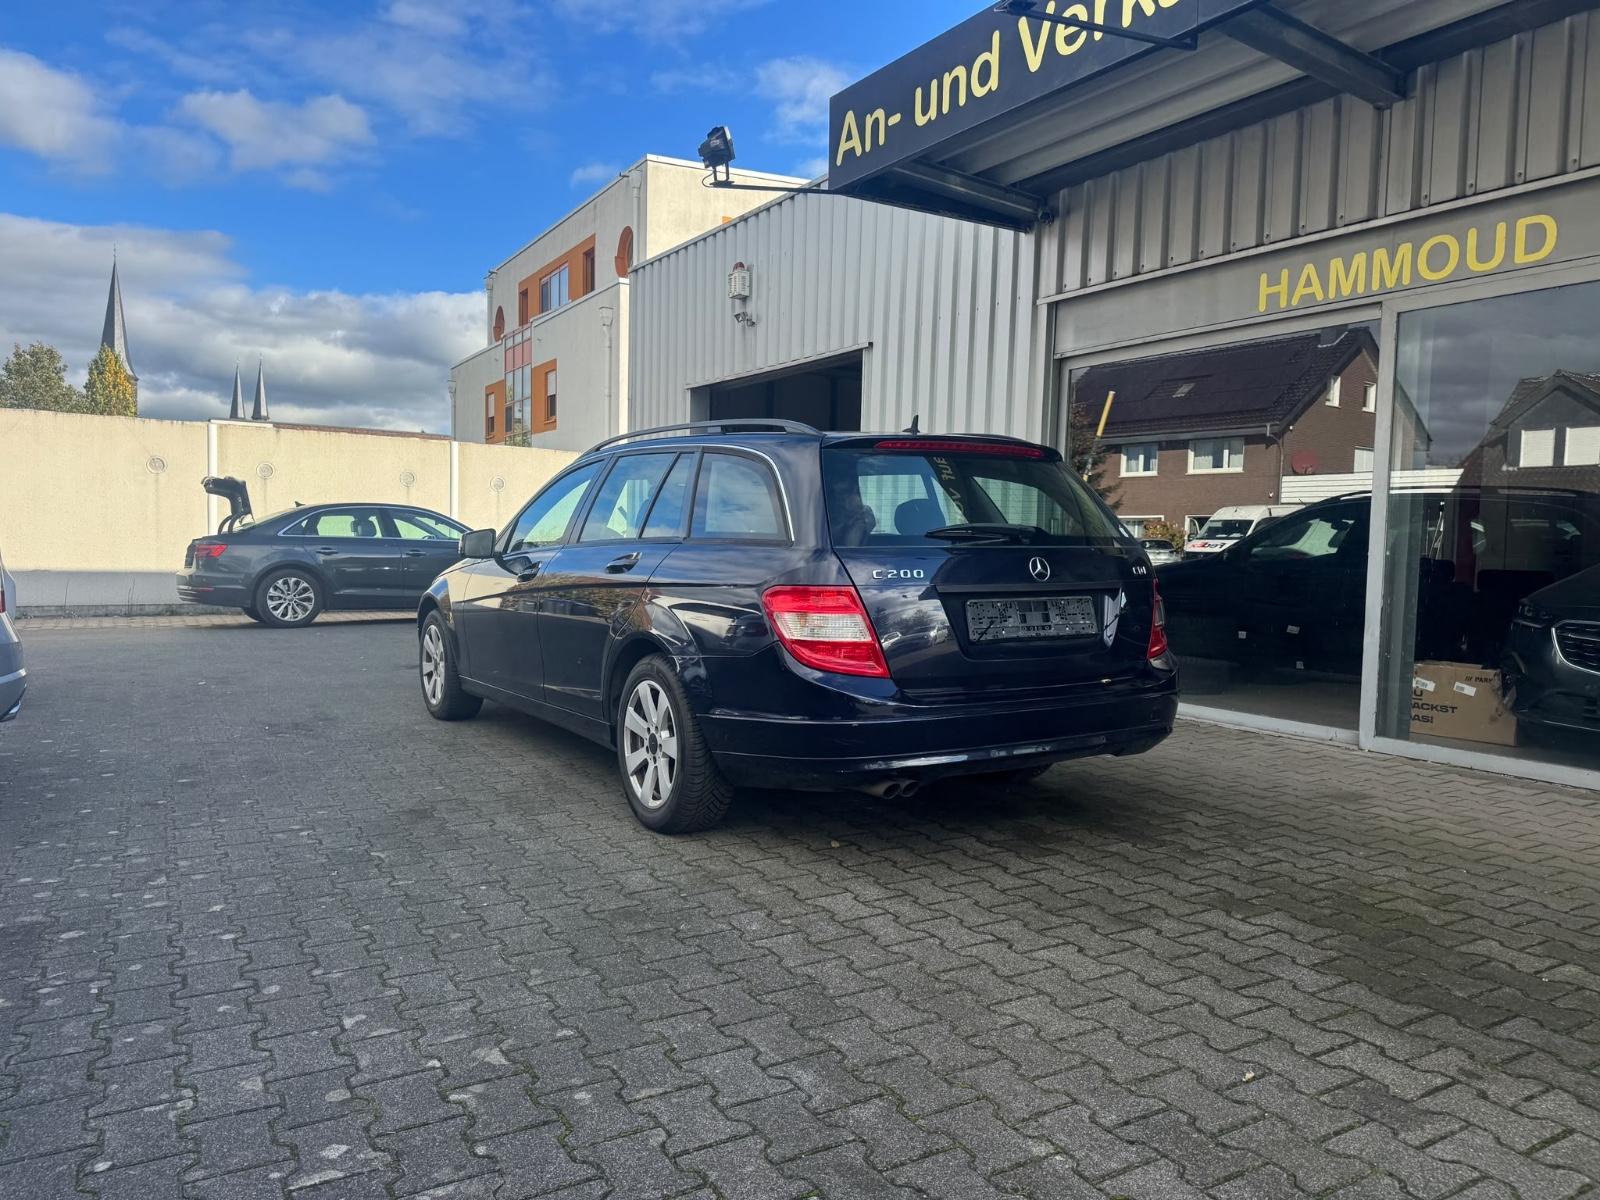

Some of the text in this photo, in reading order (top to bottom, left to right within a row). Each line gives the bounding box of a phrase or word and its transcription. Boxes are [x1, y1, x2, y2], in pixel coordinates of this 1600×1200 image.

[836, 107, 901, 167] An-
[914, 30, 1000, 127] und
[1258, 214, 1559, 312] HAMMOUD
[872, 569, 924, 579] C 200
[1411, 702, 1458, 714] ACKST
